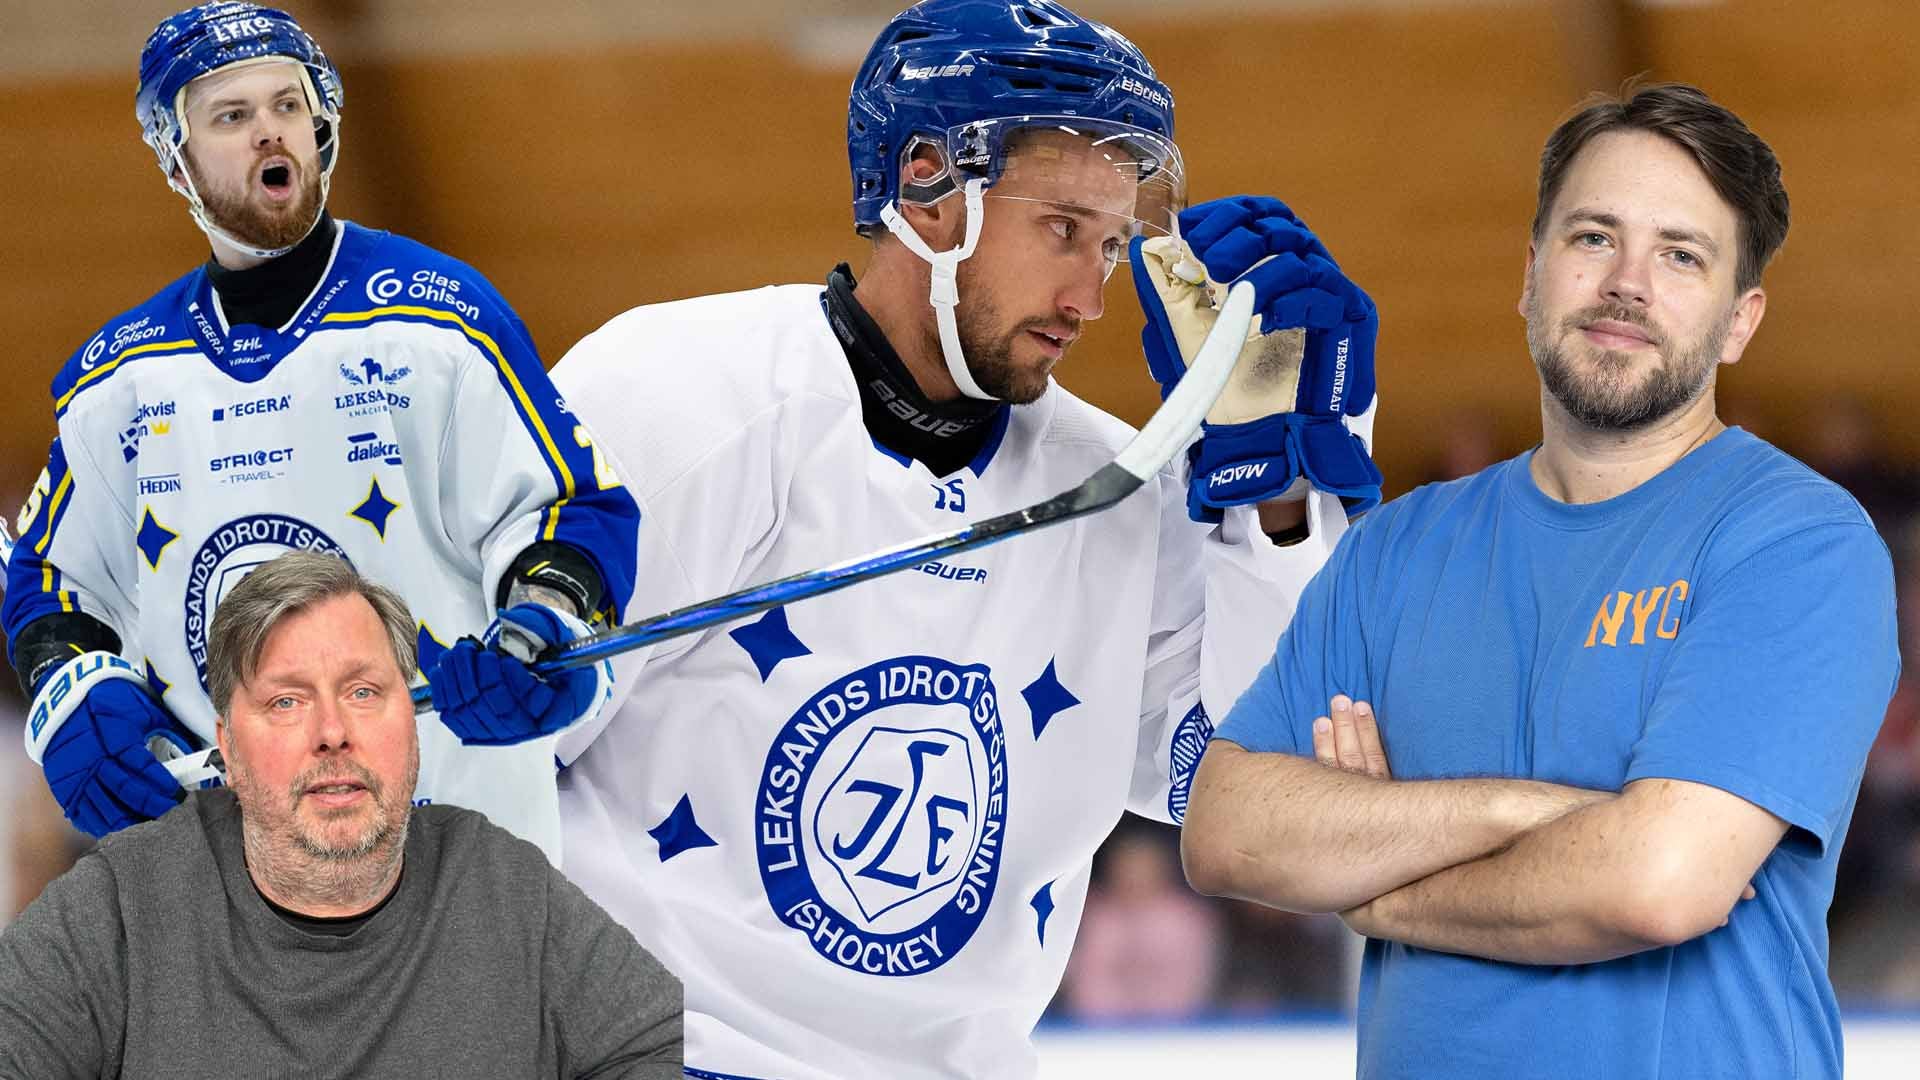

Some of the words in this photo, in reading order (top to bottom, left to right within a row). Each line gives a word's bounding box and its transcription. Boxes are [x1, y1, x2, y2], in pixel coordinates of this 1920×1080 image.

[902, 64, 975, 81] BAUER
[1121, 76, 1169, 111] BAUER
[412, 270, 460, 292] Clas
[304, 279, 349, 326] TEGERA
[408, 283, 480, 320] Ohlson
[109, 325, 165, 354] Ohlson
[114, 316, 150, 339] Clas
[194, 312, 225, 355] TEGERA
[232, 337, 263, 352] SHL
[1329, 337, 1350, 412] VERONNEAU
[229, 395, 291, 417] EGERA
[335, 389, 411, 409] LEKSADS
[869, 379, 976, 437] BAUE
[140, 479, 182, 495] HEDIN
[230, 471, 274, 484] TRAVEL
[1209, 462, 1269, 489] MACH
[930, 478, 966, 513] 15
[911, 561, 988, 584] AUER
[1583, 578, 1690, 649] NYC
[764, 679, 870, 873] LEKSANDS
[785, 898, 943, 973] ISHOCKEY
